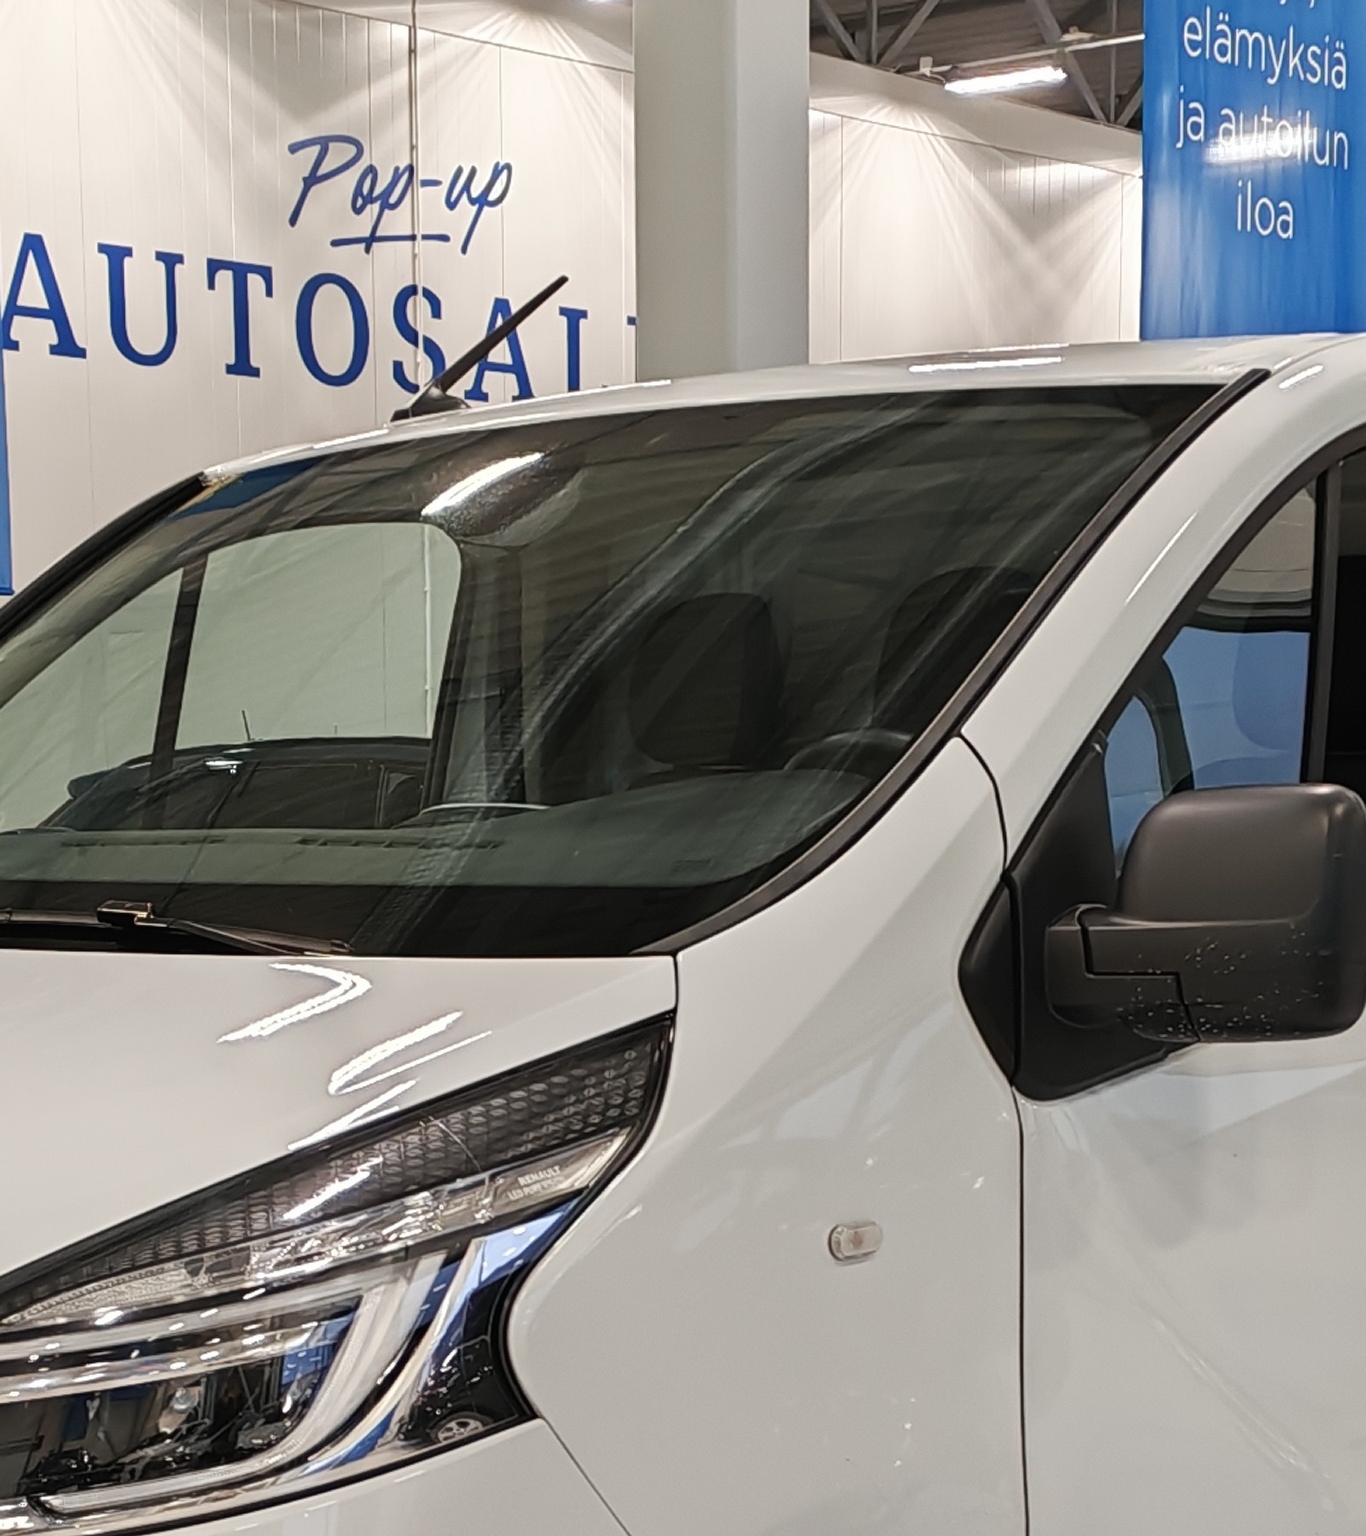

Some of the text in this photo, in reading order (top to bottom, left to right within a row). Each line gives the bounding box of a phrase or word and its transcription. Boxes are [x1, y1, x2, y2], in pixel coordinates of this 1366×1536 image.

[1183, 5, 1347, 90] elämyksiä
[1176, 85, 1349, 170] ja autoilun
[288, 135, 513, 254] Pop-up
[1237, 179, 1294, 239] iloa
